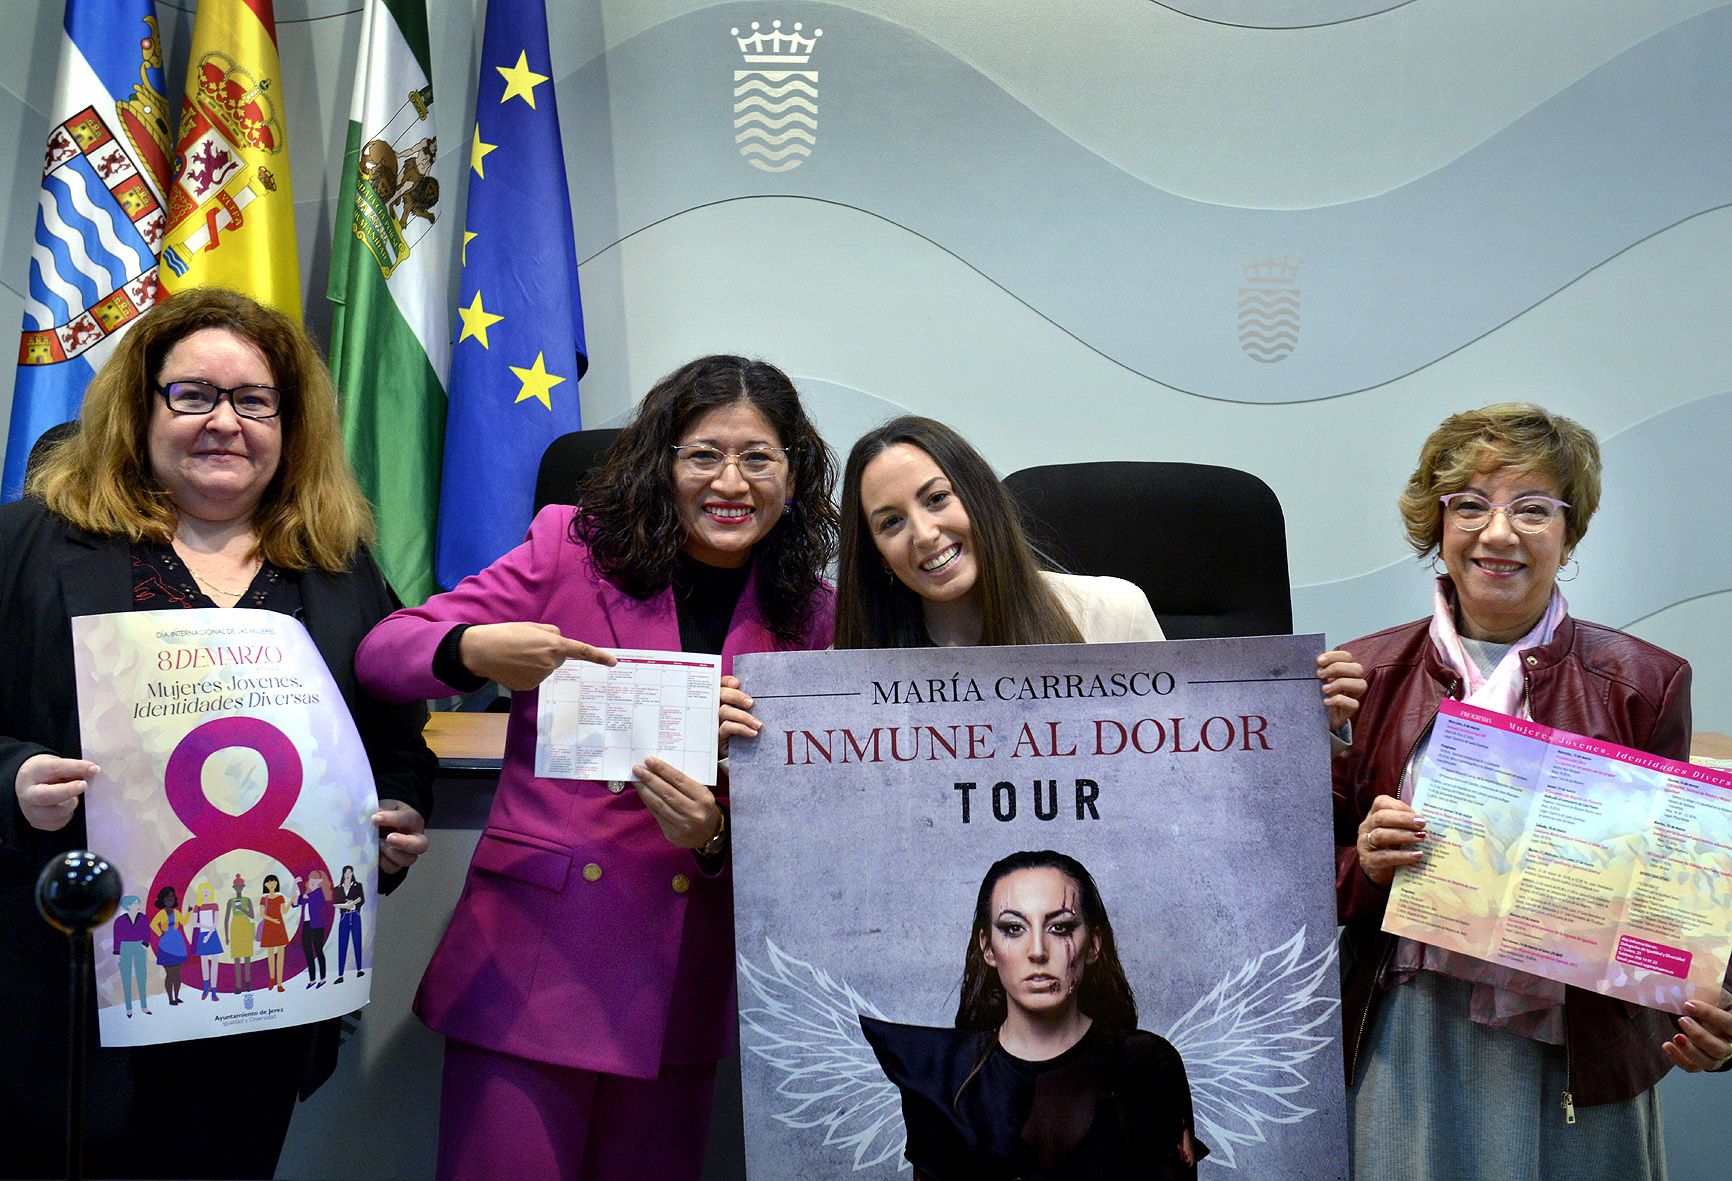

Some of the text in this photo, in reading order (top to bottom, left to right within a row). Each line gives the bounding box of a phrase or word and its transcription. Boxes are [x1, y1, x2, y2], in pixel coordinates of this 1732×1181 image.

[169, 629, 226, 638] INTERNACIONAL
[157, 650, 173, 672] 8
[148, 681, 224, 701] Mujeres
[871, 671, 1177, 706] MARÍA CARRASCO
[133, 691, 321, 720] Identidades Diversas
[783, 715, 1274, 766] INMUNE AL DOLOR
[1509, 722, 1555, 742] Mujeres
[1615, 751, 1688, 776] Identidades
[954, 778, 1102, 825] TOUR
[214, 1011, 259, 1022] Ayuntamiento
[268, 1008, 284, 1016] Jerez
